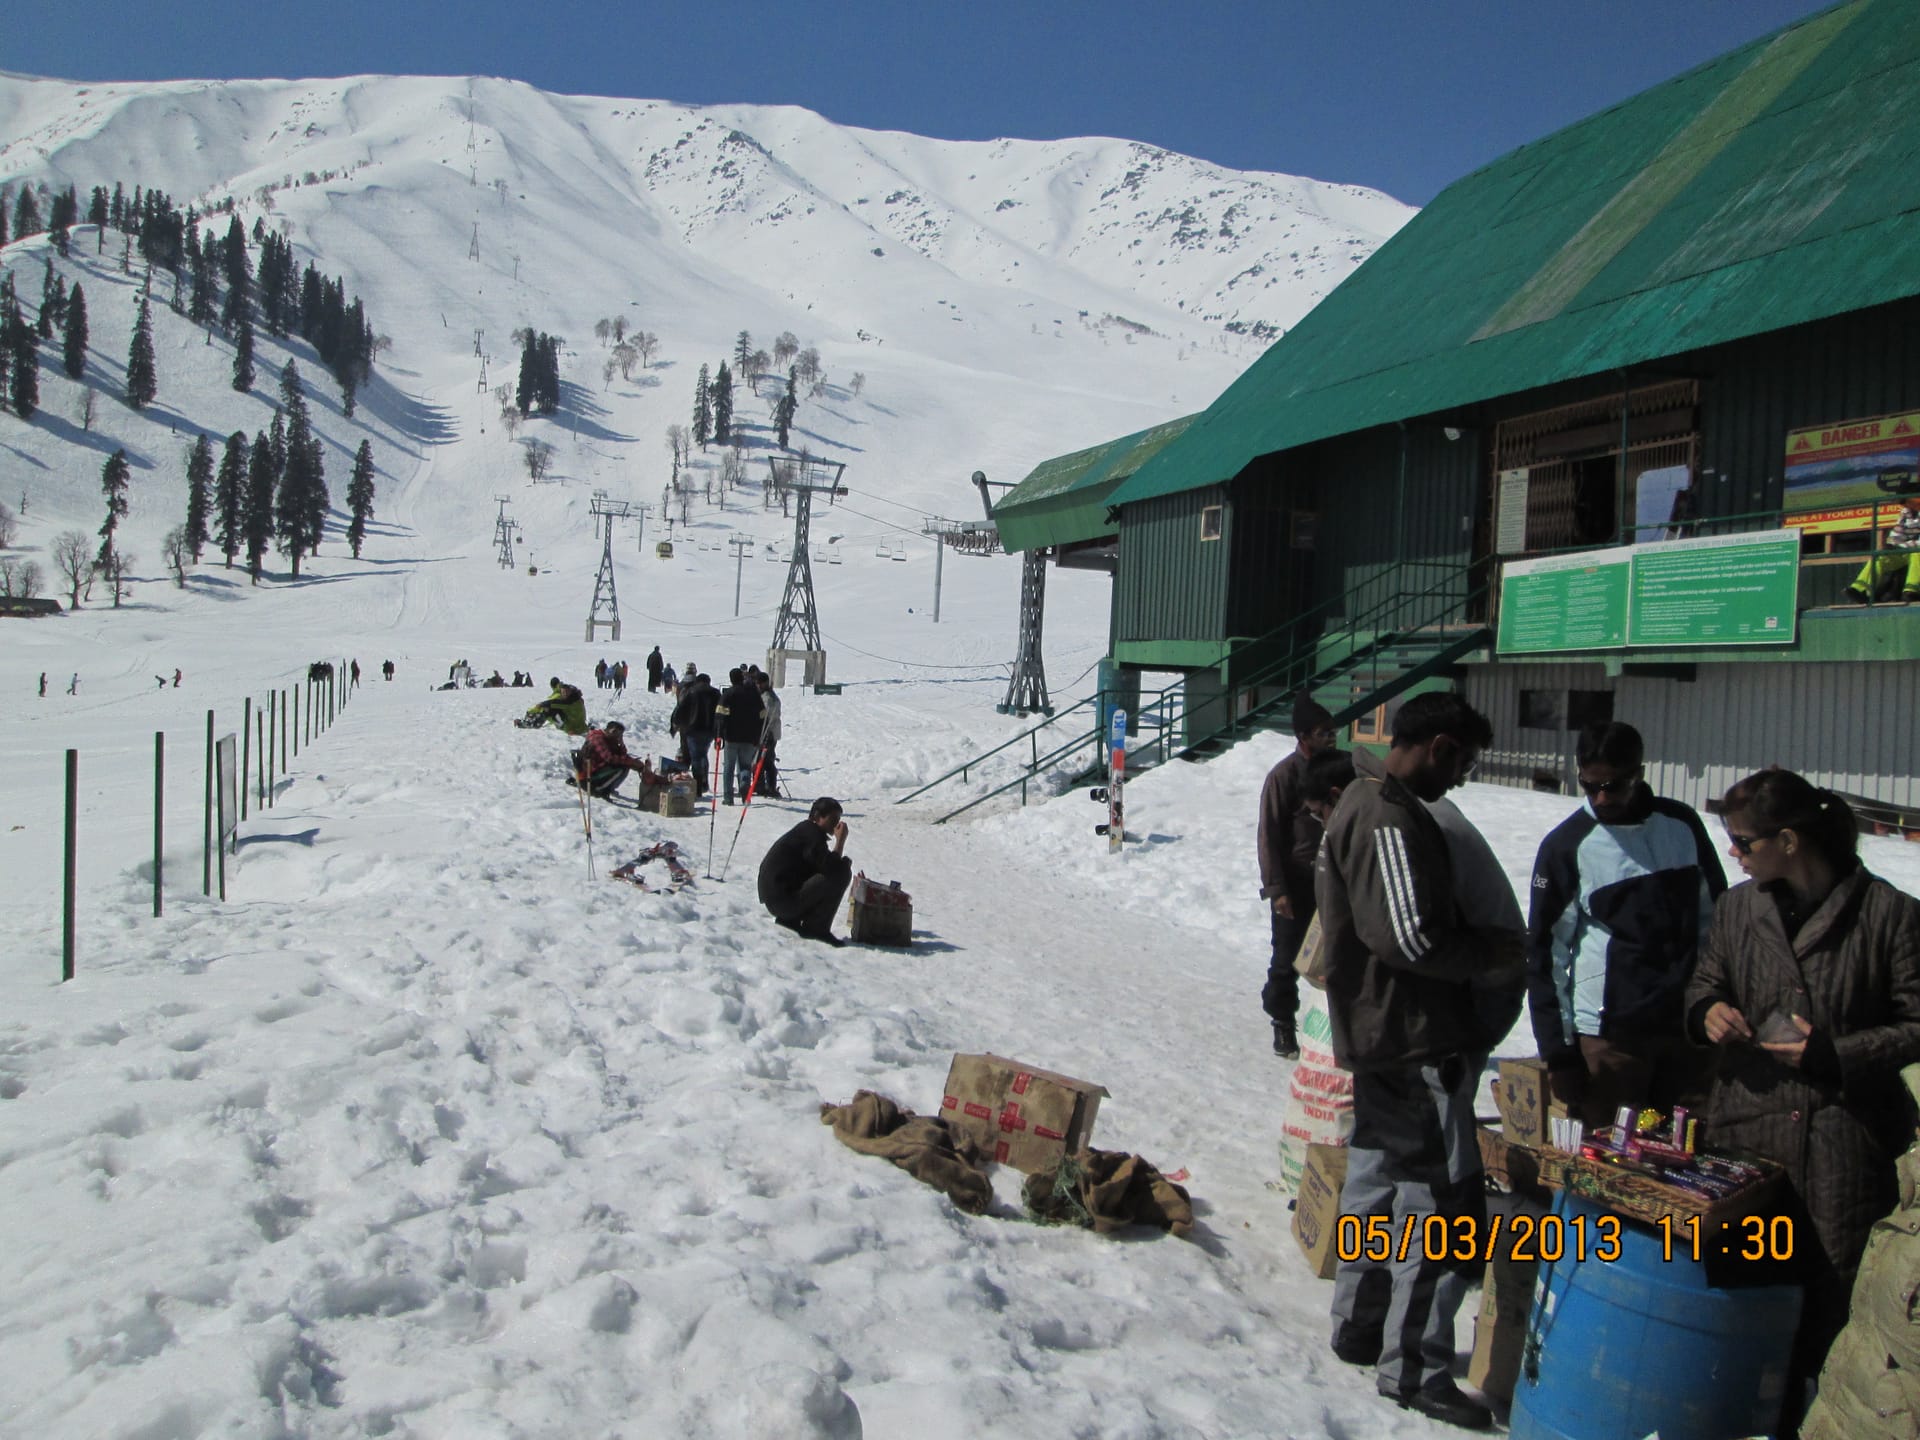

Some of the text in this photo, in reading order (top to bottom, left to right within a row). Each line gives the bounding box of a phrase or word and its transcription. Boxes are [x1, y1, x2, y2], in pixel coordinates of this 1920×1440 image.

[1821, 423, 1881, 446] DANGER
[1786, 515, 1807, 524] RIDE
[1809, 513, 1823, 521] AT
[1826, 509, 1855, 519] YOUR
[1303, 1104, 1336, 1122] INDIA
